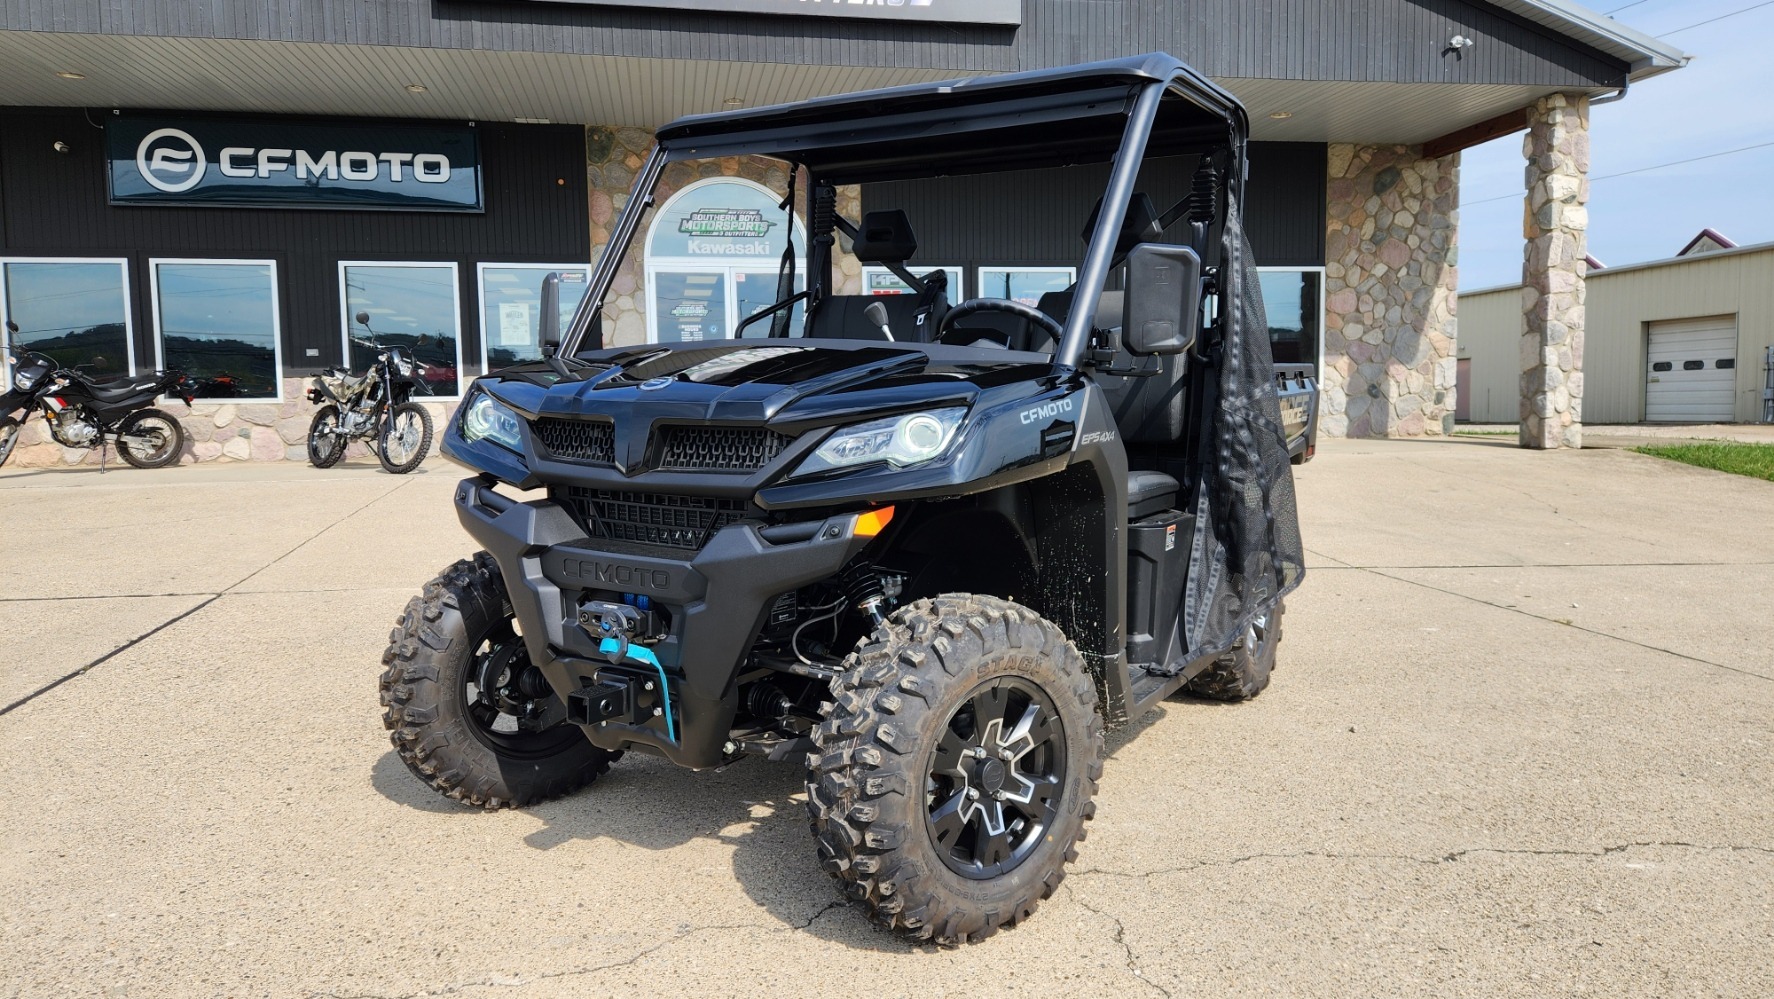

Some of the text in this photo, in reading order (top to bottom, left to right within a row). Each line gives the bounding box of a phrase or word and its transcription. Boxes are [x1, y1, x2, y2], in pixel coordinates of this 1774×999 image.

[219, 147, 451, 183] CFMOTO
[692, 213, 761, 222] SOUTHERN BOYS
[681, 220, 769, 231] MOTORSPORTS
[687, 241, 770, 255] Kawasaki
[1020, 398, 1073, 425] CFMOTO
[1081, 430, 1116, 445] EPS 4X4
[563, 558, 671, 590] CFMOTO
